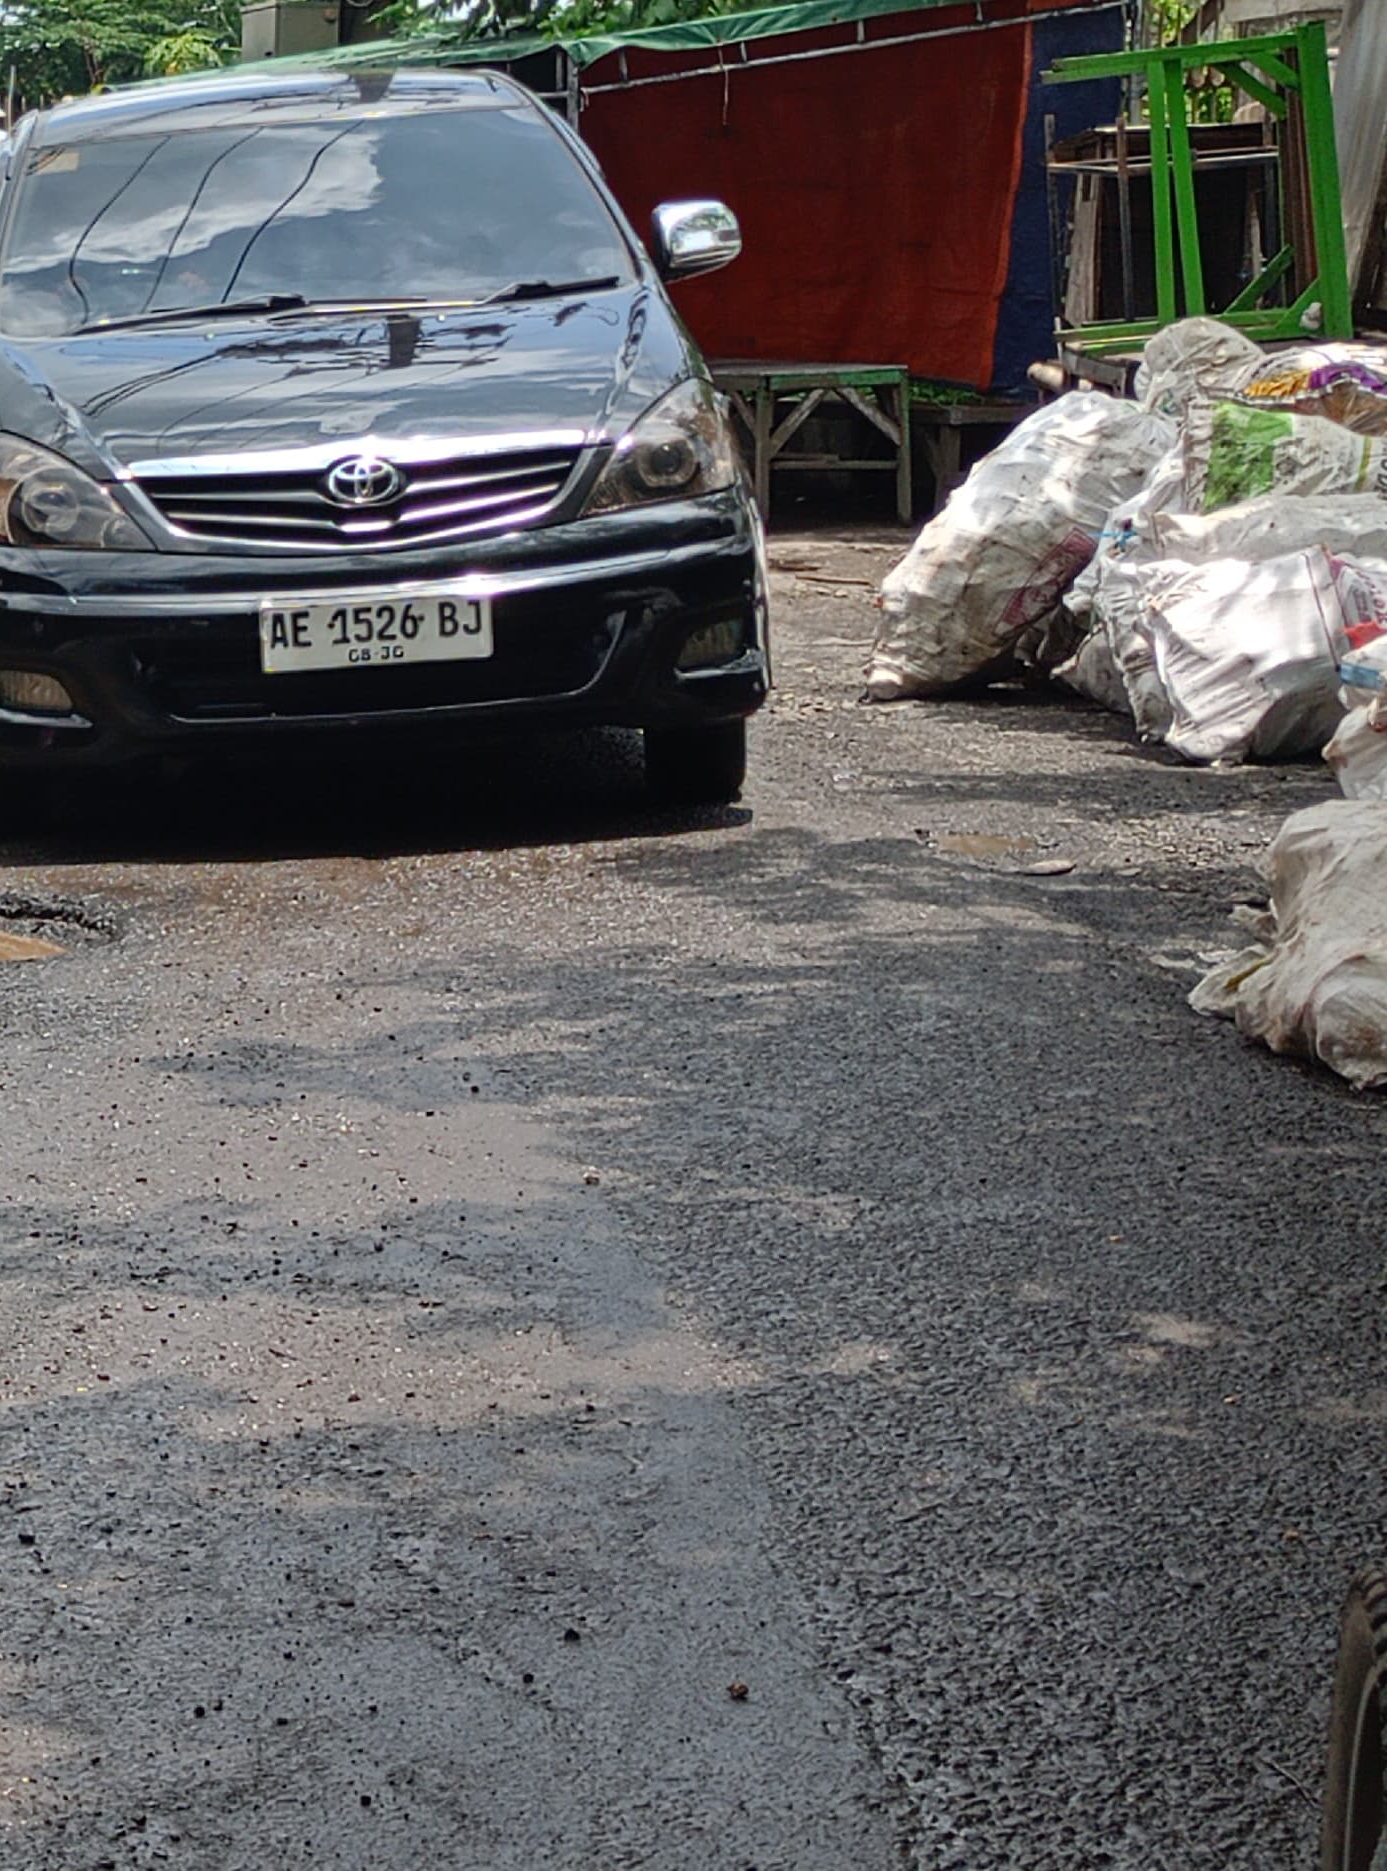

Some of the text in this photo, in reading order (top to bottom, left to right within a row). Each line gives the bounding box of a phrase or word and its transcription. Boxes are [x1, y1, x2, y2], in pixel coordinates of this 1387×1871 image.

[270, 600, 483, 648] AE 1526 BJ
